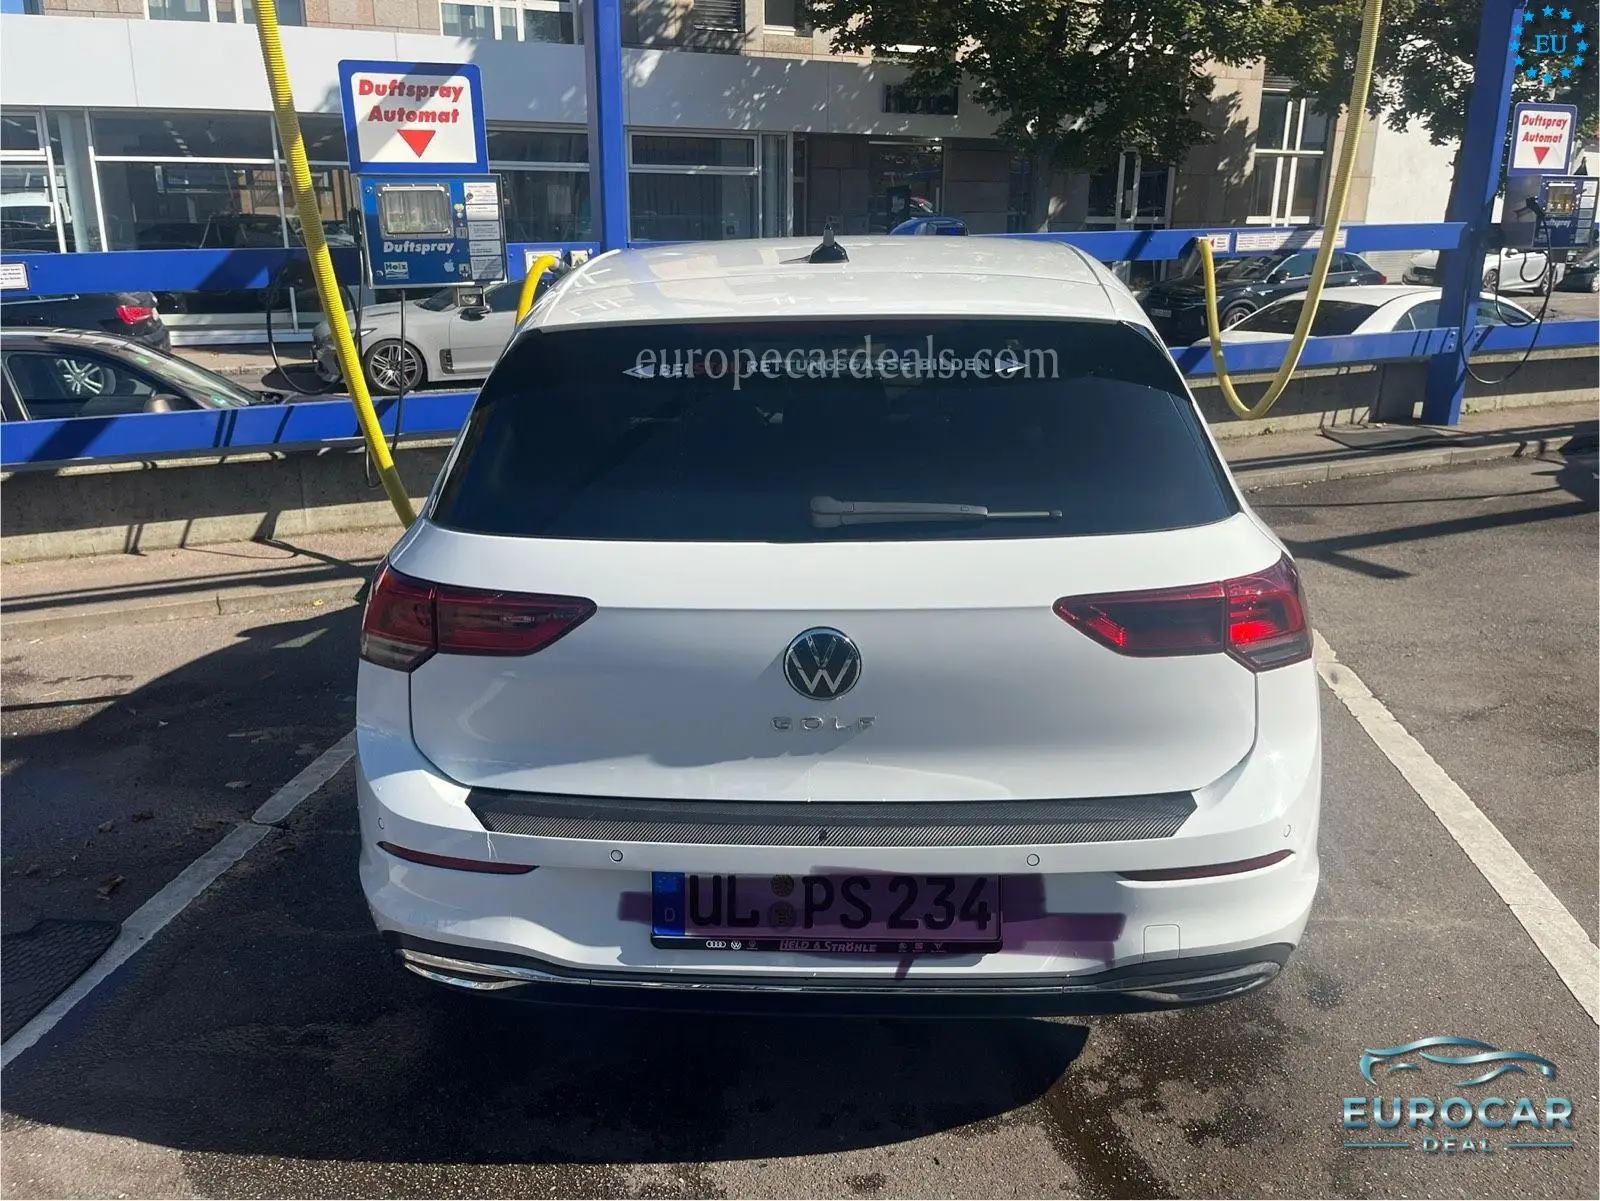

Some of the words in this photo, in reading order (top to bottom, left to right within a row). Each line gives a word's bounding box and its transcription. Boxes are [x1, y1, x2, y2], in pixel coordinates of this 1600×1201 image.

[358, 79, 464, 103] Duftspray
[368, 105, 460, 123] Automat
[1522, 114, 1568, 131] Duftspray
[1522, 131, 1563, 144] Automat
[383, 241, 455, 255] Duftspray
[919, 358, 990, 371] BILDEN
[770, 716, 877, 731] GOLF
[689, 874, 760, 927] UL
[802, 875, 873, 930] PS
[888, 876, 991, 931] 234
[664, 907, 676, 922] D
